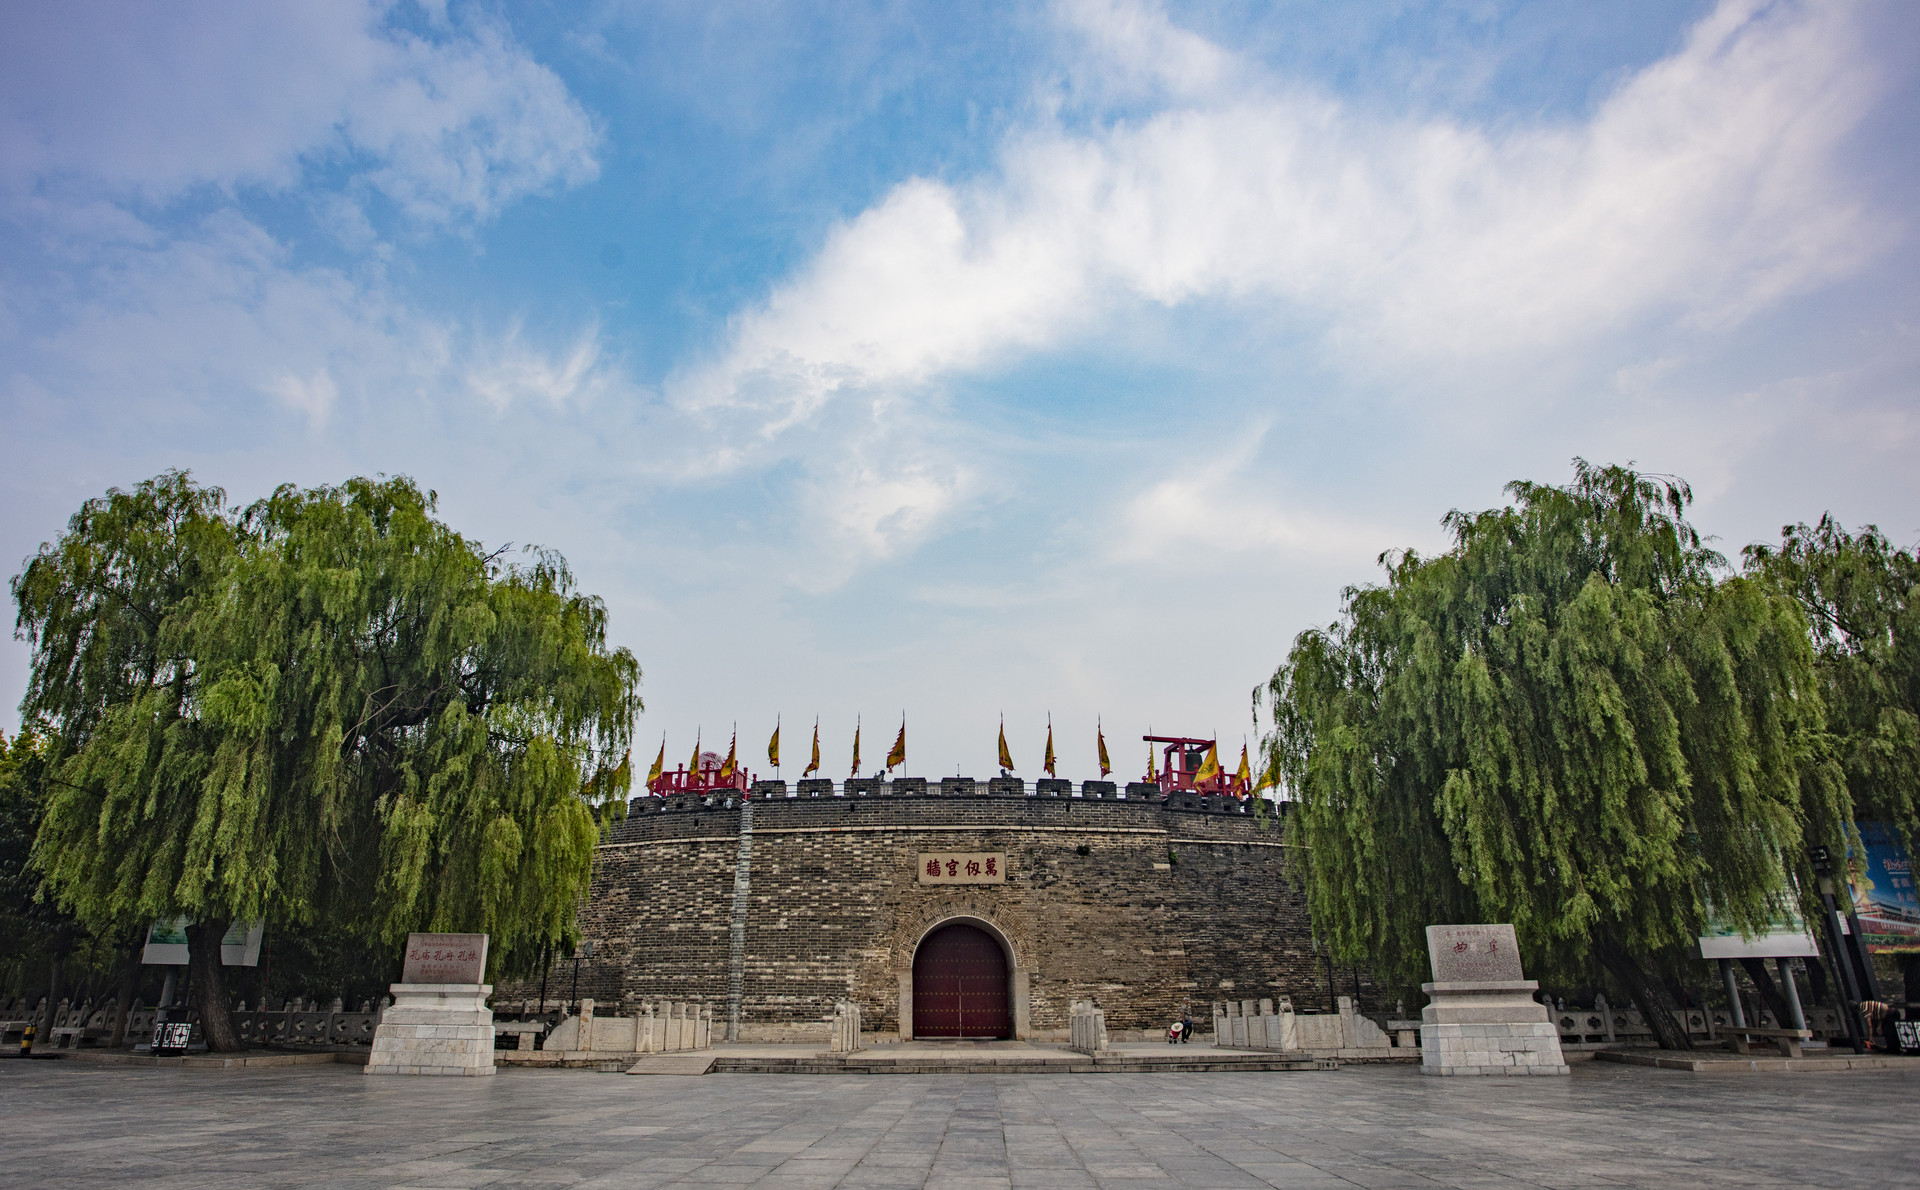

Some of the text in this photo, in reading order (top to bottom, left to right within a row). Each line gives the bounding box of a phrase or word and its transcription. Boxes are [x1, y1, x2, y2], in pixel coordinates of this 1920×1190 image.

[409, 948, 478, 961] 孔庙 孔府 孔林
[1453, 938, 1499, 959] 曲阜
